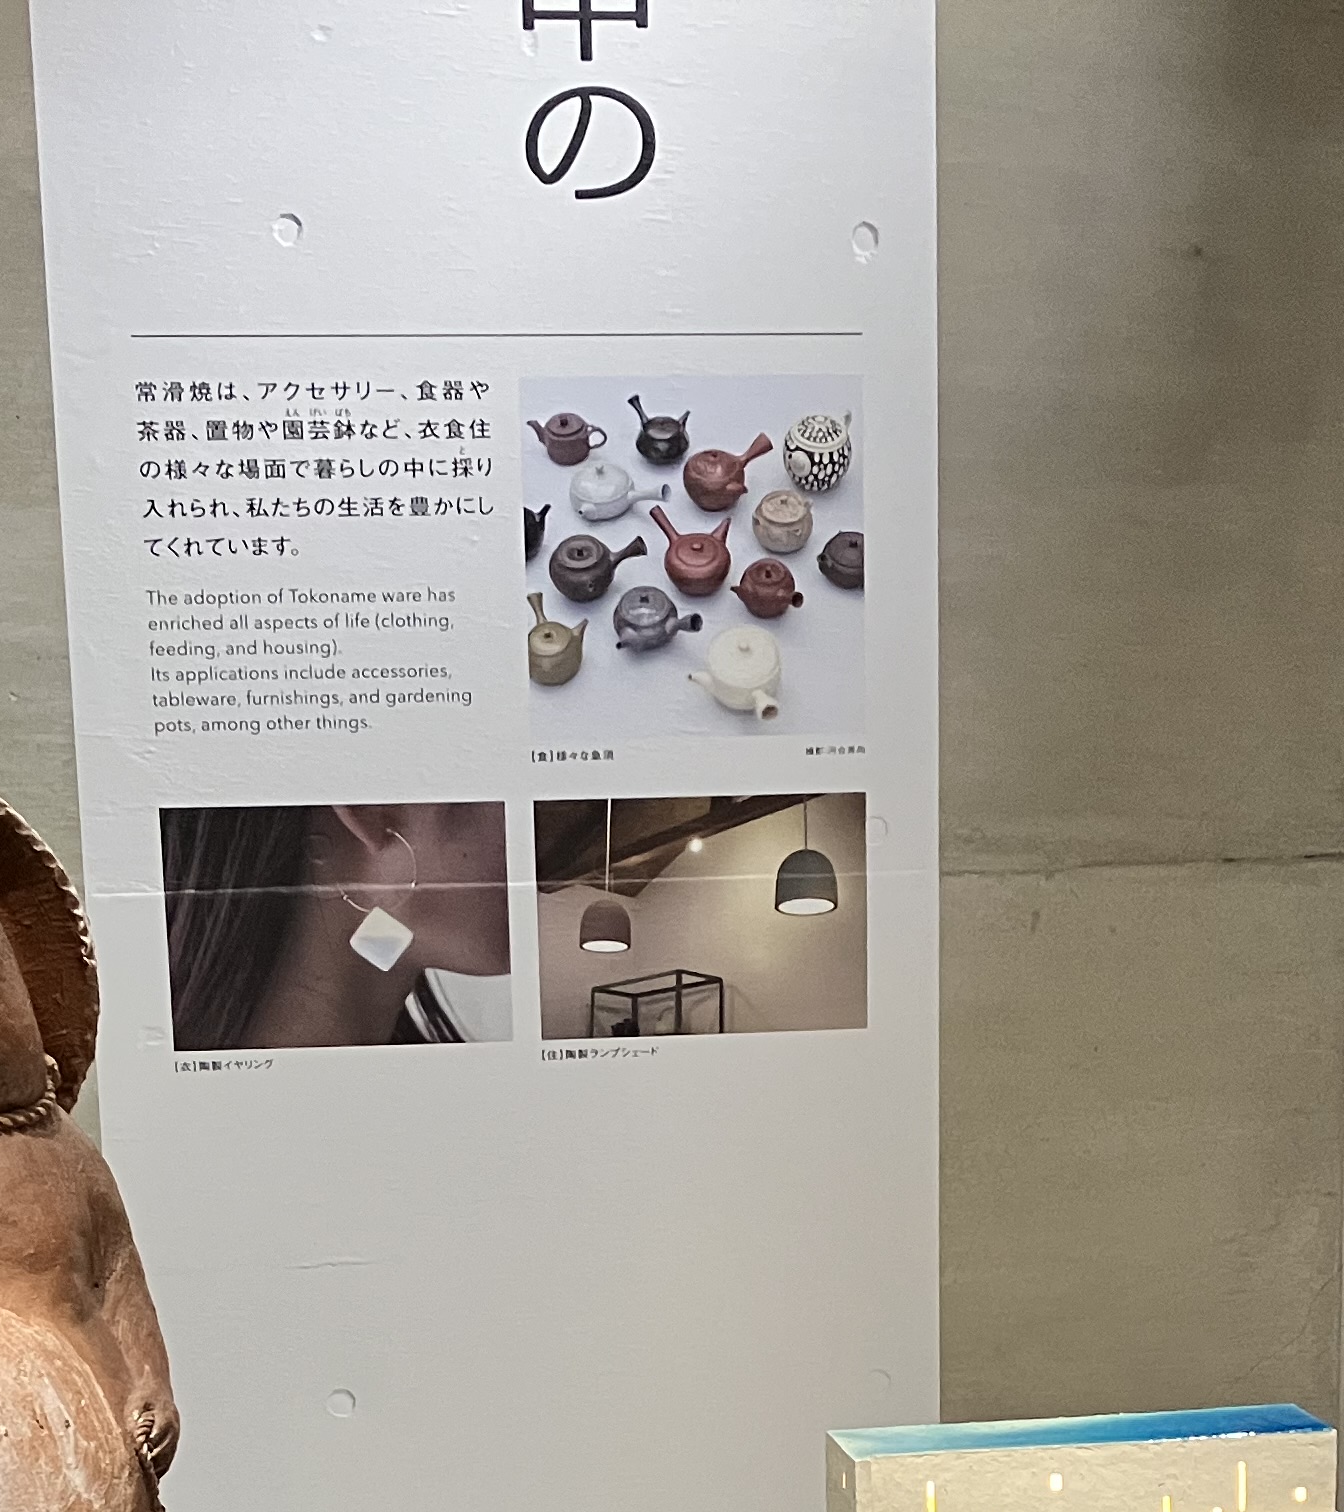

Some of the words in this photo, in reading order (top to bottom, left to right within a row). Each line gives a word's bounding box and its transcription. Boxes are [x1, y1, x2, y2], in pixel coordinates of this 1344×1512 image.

[135, 380, 489, 402] 常滑焼は、アクセサリー、食器や
[137, 421, 491, 441] 茶器、置物や園芸鉢など、衣食住
[140, 458, 492, 480] の様々な場面で暮らしの中に採り
[143, 496, 494, 518] 入れられ、私たちの生活を豊かにし
[144, 536, 300, 558] てくれています。
[145, 589, 178, 607] The
[182, 588, 263, 612] adoption
[267, 588, 284, 606] of
[288, 587, 376, 605] Tokoname
[382, 592, 421, 603] ware
[427, 585, 455, 602] has
[147, 614, 223, 633] enriched
[230, 613, 248, 632] all
[254, 616, 318, 636] aspects
[323, 612, 340, 629] of
[345, 612, 370, 630] life
[373, 610, 456, 636] (clothing,
[147, 640, 220, 660] feeding,
[226, 640, 257, 655] and
[263, 637, 344, 660] housing).
[151, 667, 169, 683] Its
[176, 664, 278, 686] applications
[283, 664, 347, 681] include
[352, 663, 452, 683] accessories,
[152, 691, 241, 710] tableware,
[247, 689, 343, 709] furnishings,
[349, 688, 380, 706] and
[386, 687, 471, 710] gardening
[155, 719, 196, 737] pots,
[200, 718, 262, 736] among
[267, 715, 313, 733] other
[317, 714, 372, 733] things.
